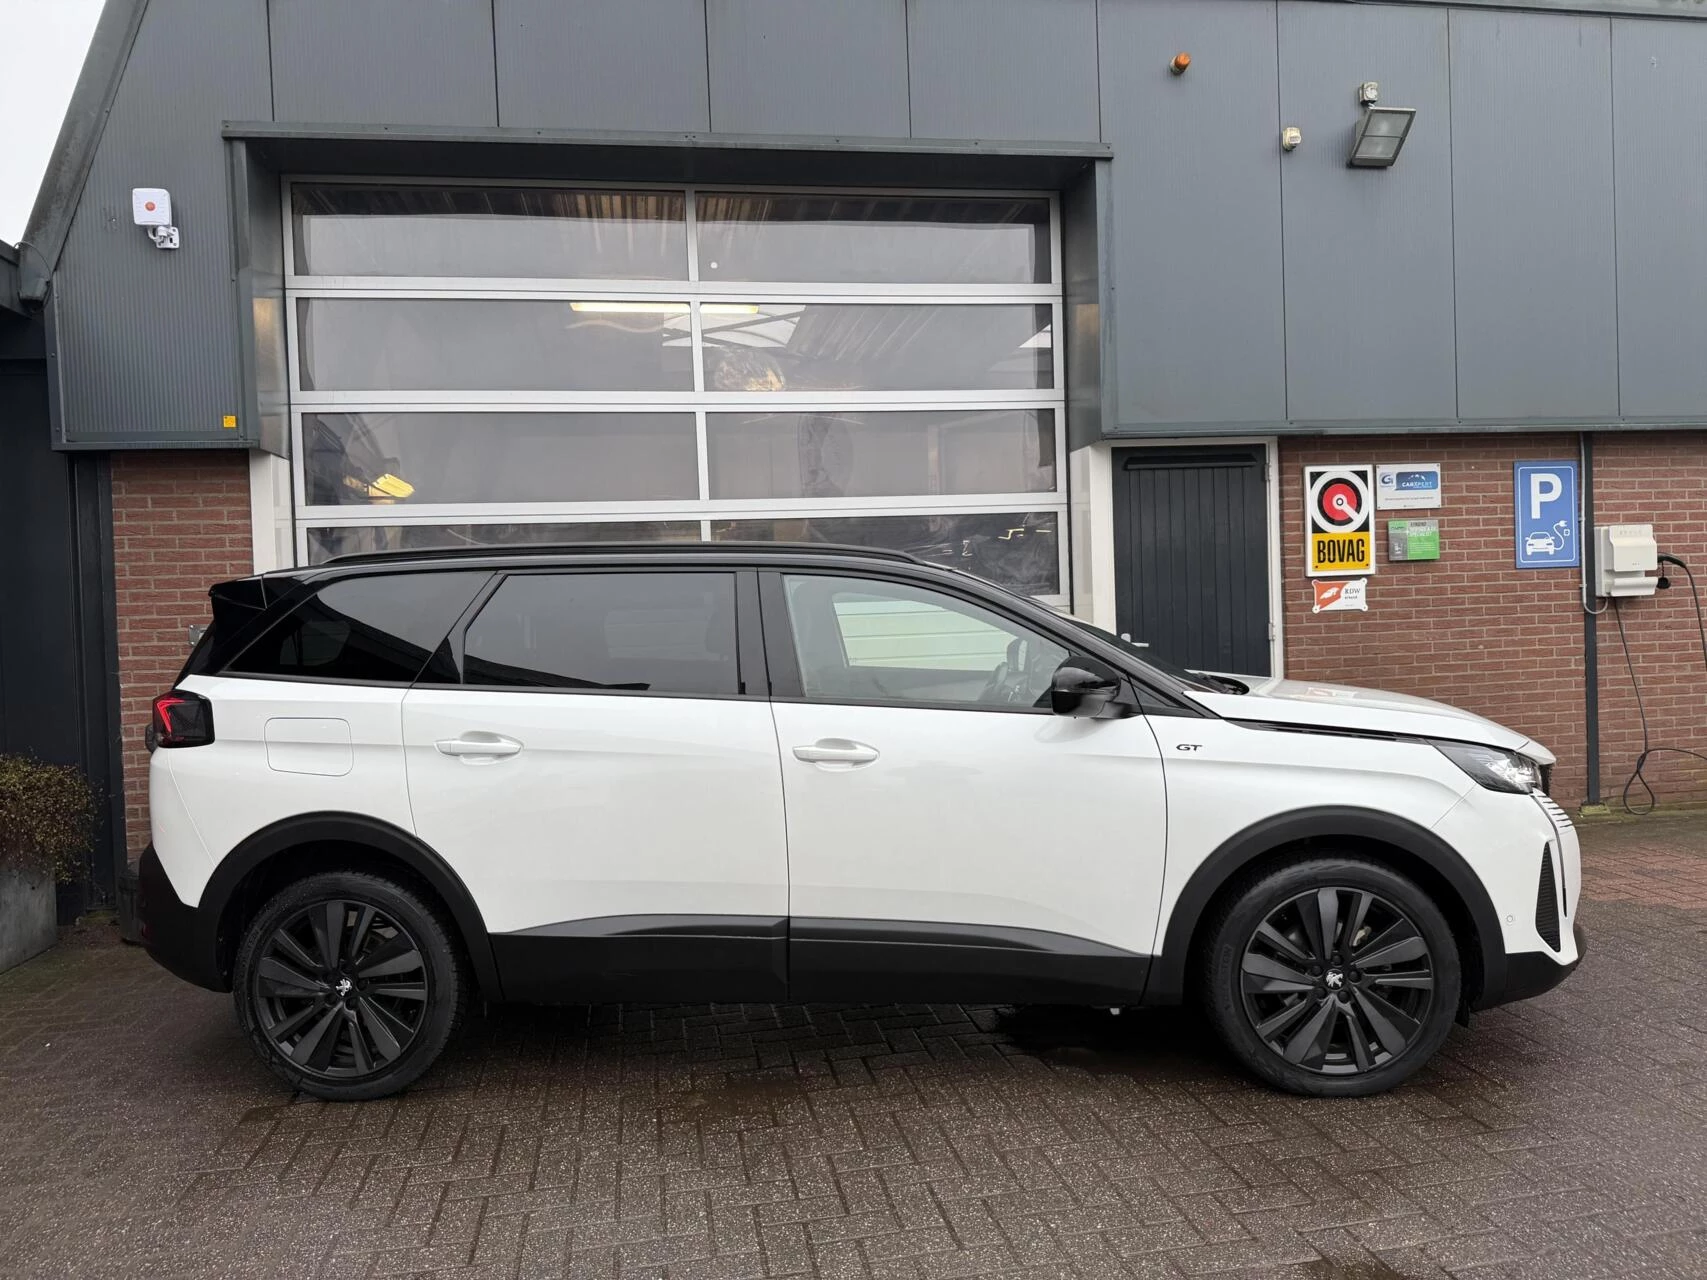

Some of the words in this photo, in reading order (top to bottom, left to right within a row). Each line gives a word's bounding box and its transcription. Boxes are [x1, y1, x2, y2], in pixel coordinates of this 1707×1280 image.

[1530, 473, 1563, 519] P
[1317, 539, 1365, 564] BOVAG
[1175, 743, 1204, 752] GT
